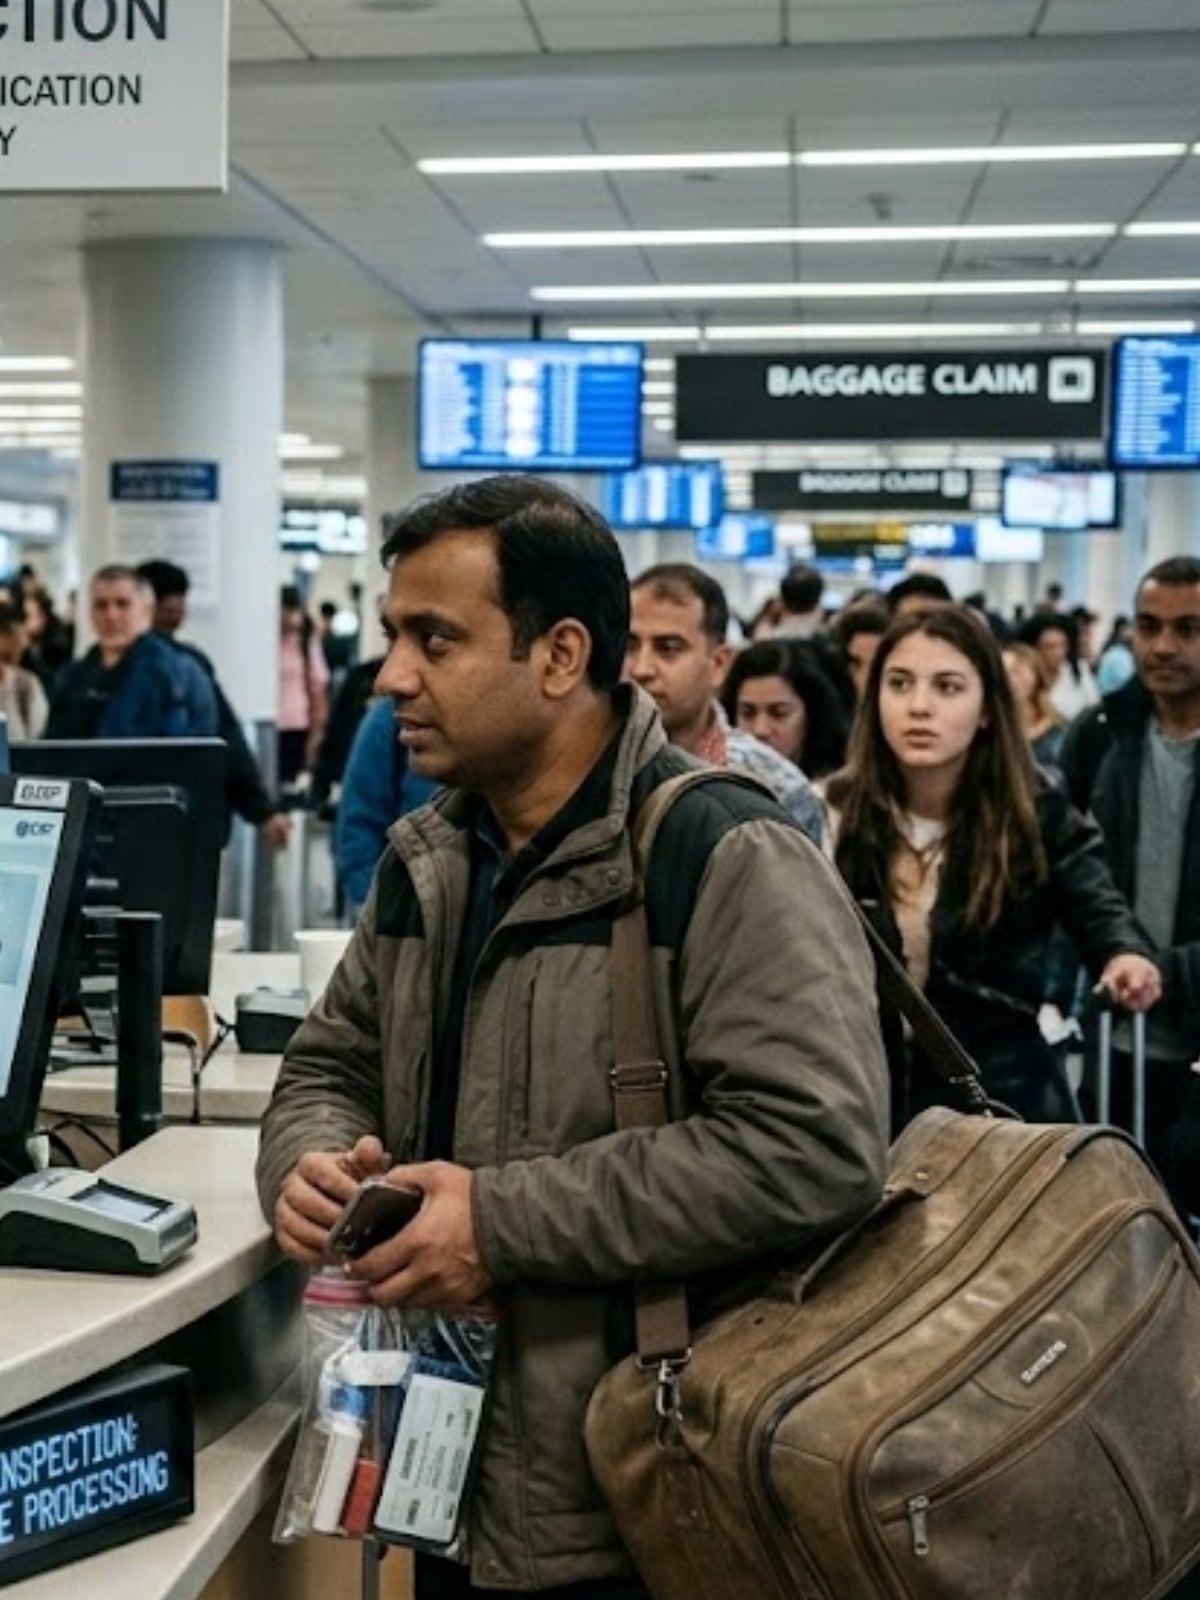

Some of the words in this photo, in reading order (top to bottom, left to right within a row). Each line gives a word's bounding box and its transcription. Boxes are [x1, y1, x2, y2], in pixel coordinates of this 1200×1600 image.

[766, 364, 926, 397] BAGGAGE
[932, 363, 1038, 395] CLAIM
[23, 1451, 168, 1535] PROCESSING
